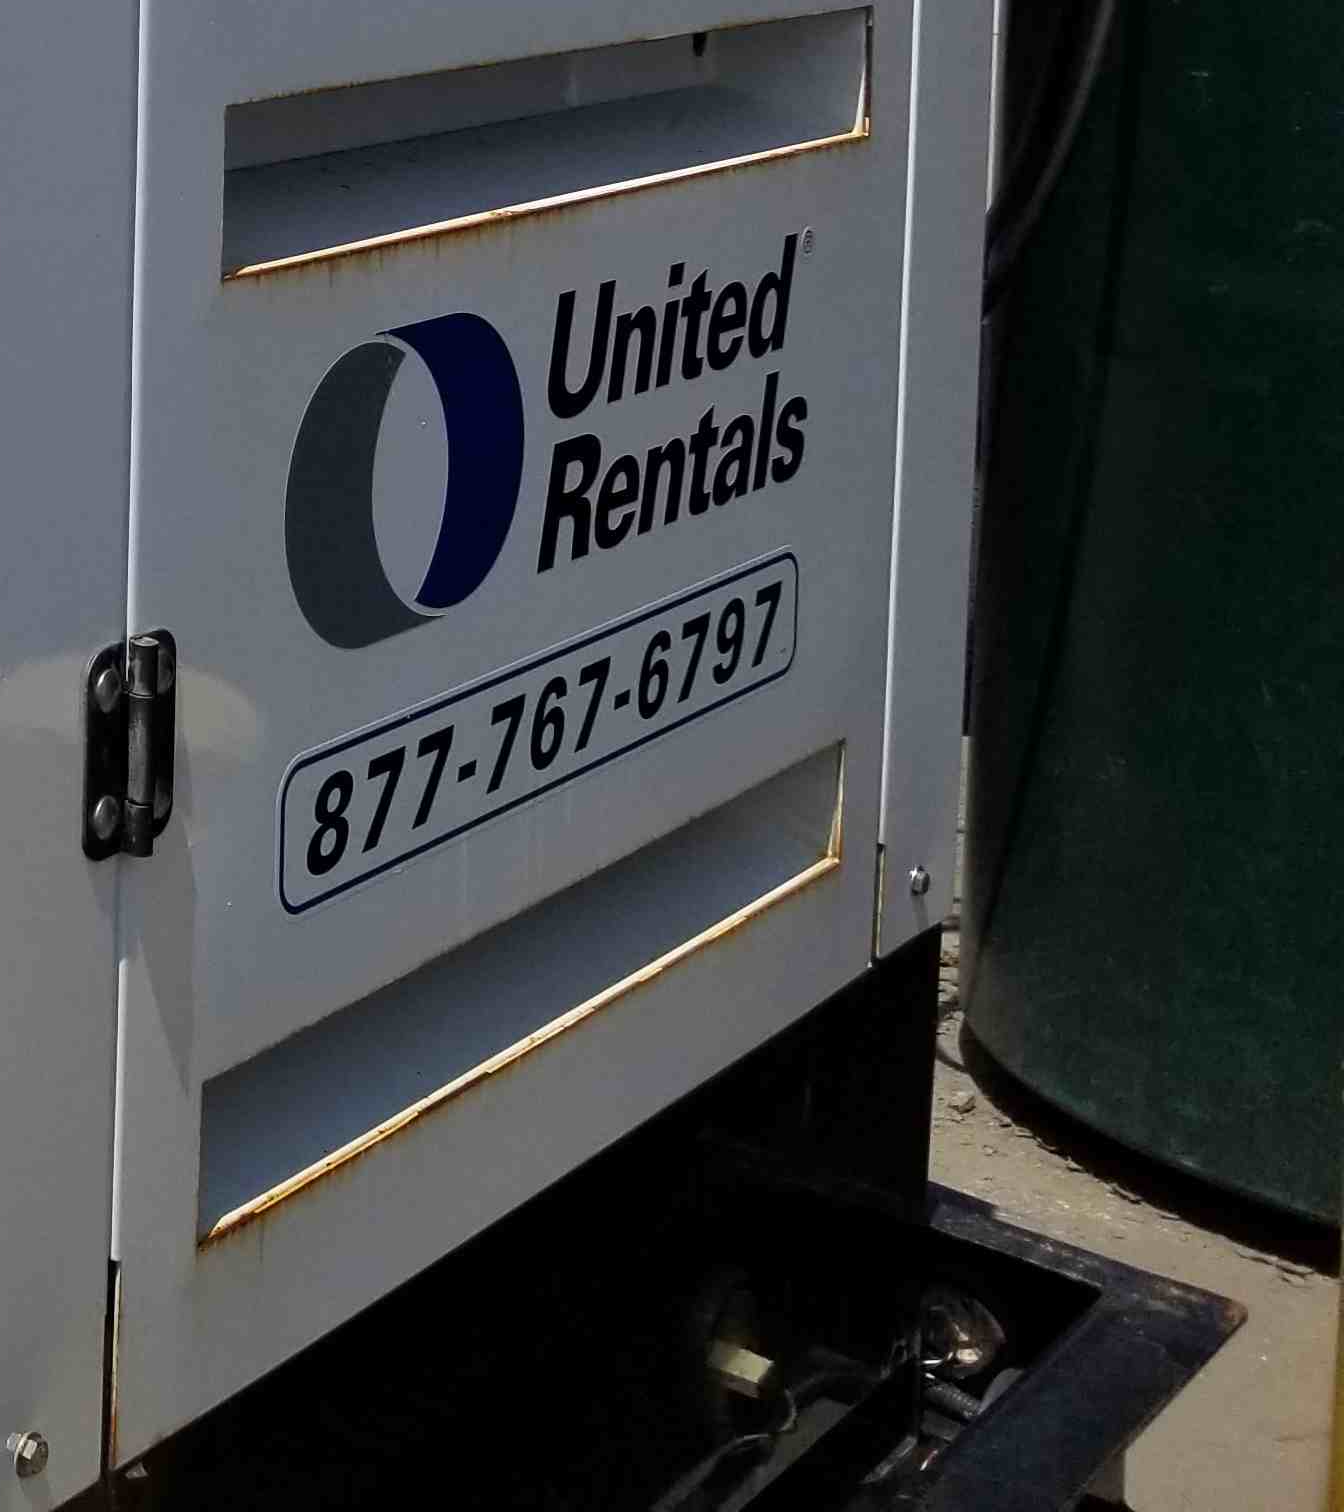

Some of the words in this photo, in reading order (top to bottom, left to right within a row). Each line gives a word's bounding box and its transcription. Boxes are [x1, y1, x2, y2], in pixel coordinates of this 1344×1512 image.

[546, 233, 797, 420] United
[537, 371, 807, 574] Rentals
[305, 580, 783, 877] 877-767-6797
